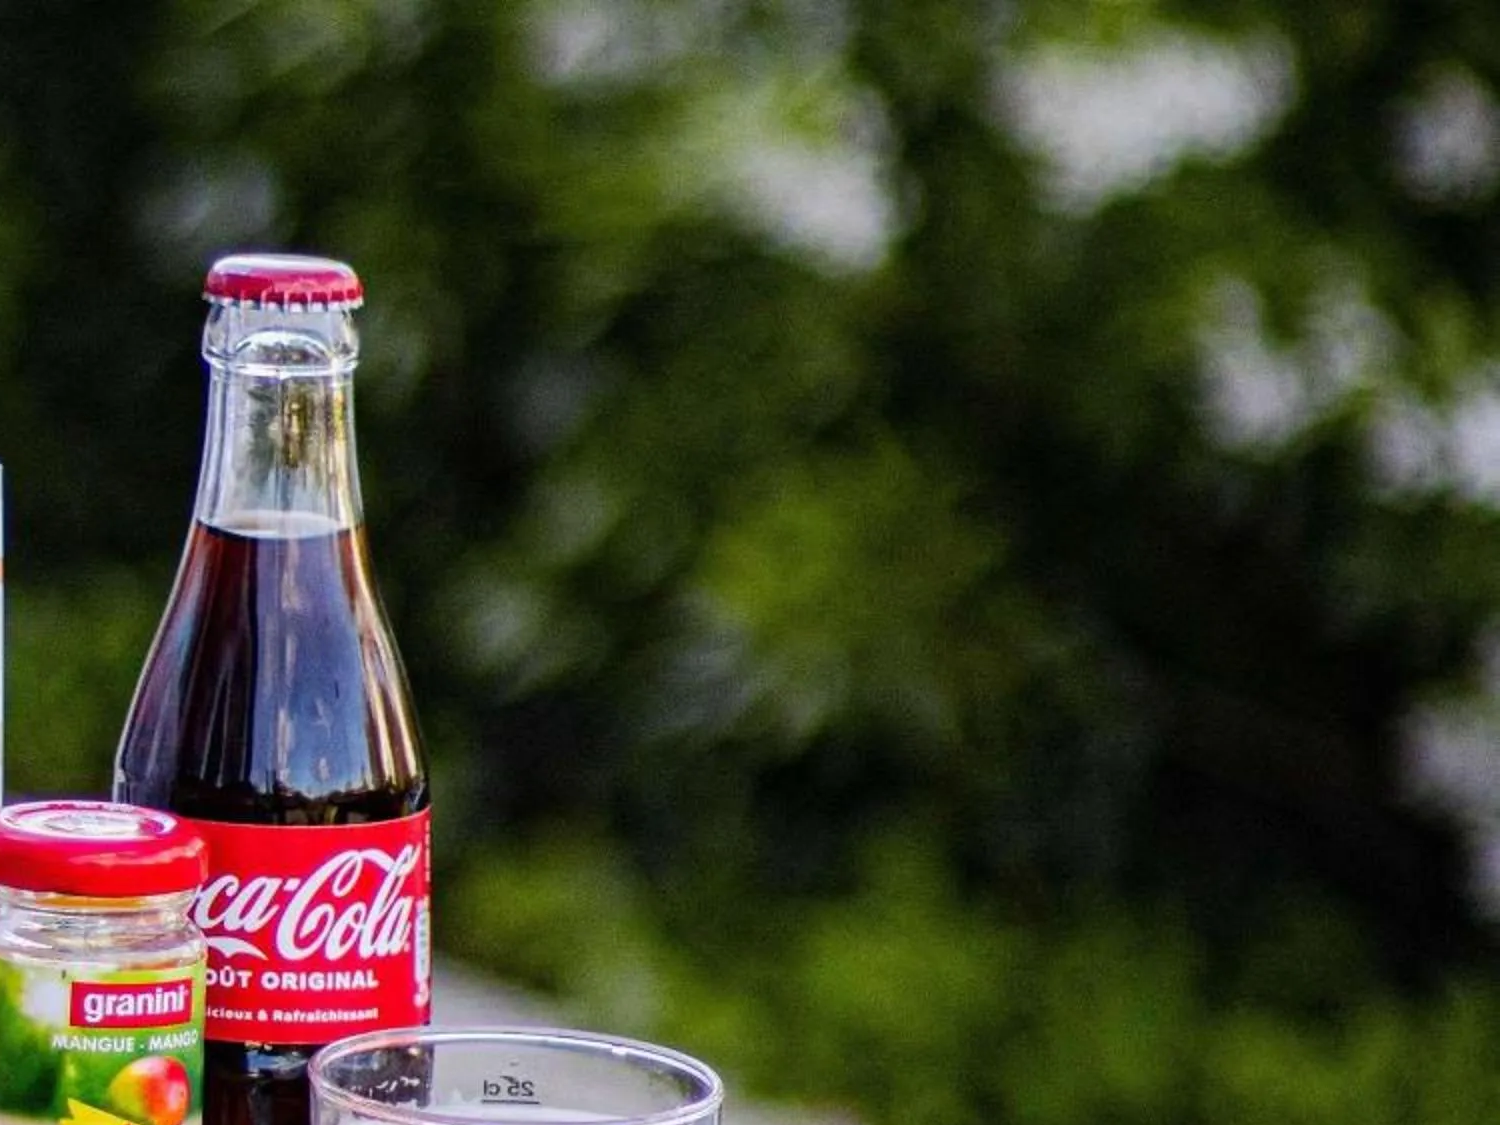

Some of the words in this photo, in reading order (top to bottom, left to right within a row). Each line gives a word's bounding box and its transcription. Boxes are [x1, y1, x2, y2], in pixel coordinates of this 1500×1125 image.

[194, 844, 420, 961] ca-Cola
[205, 965, 253, 989] OÛT
[260, 968, 379, 991] ORIGINAL
[83, 984, 187, 1023] granini
[206, 1006, 254, 1023] icieux
[257, 1008, 269, 1022] &
[51, 1033, 136, 1053] MANGUE
[149, 1028, 199, 1051] MANGO
